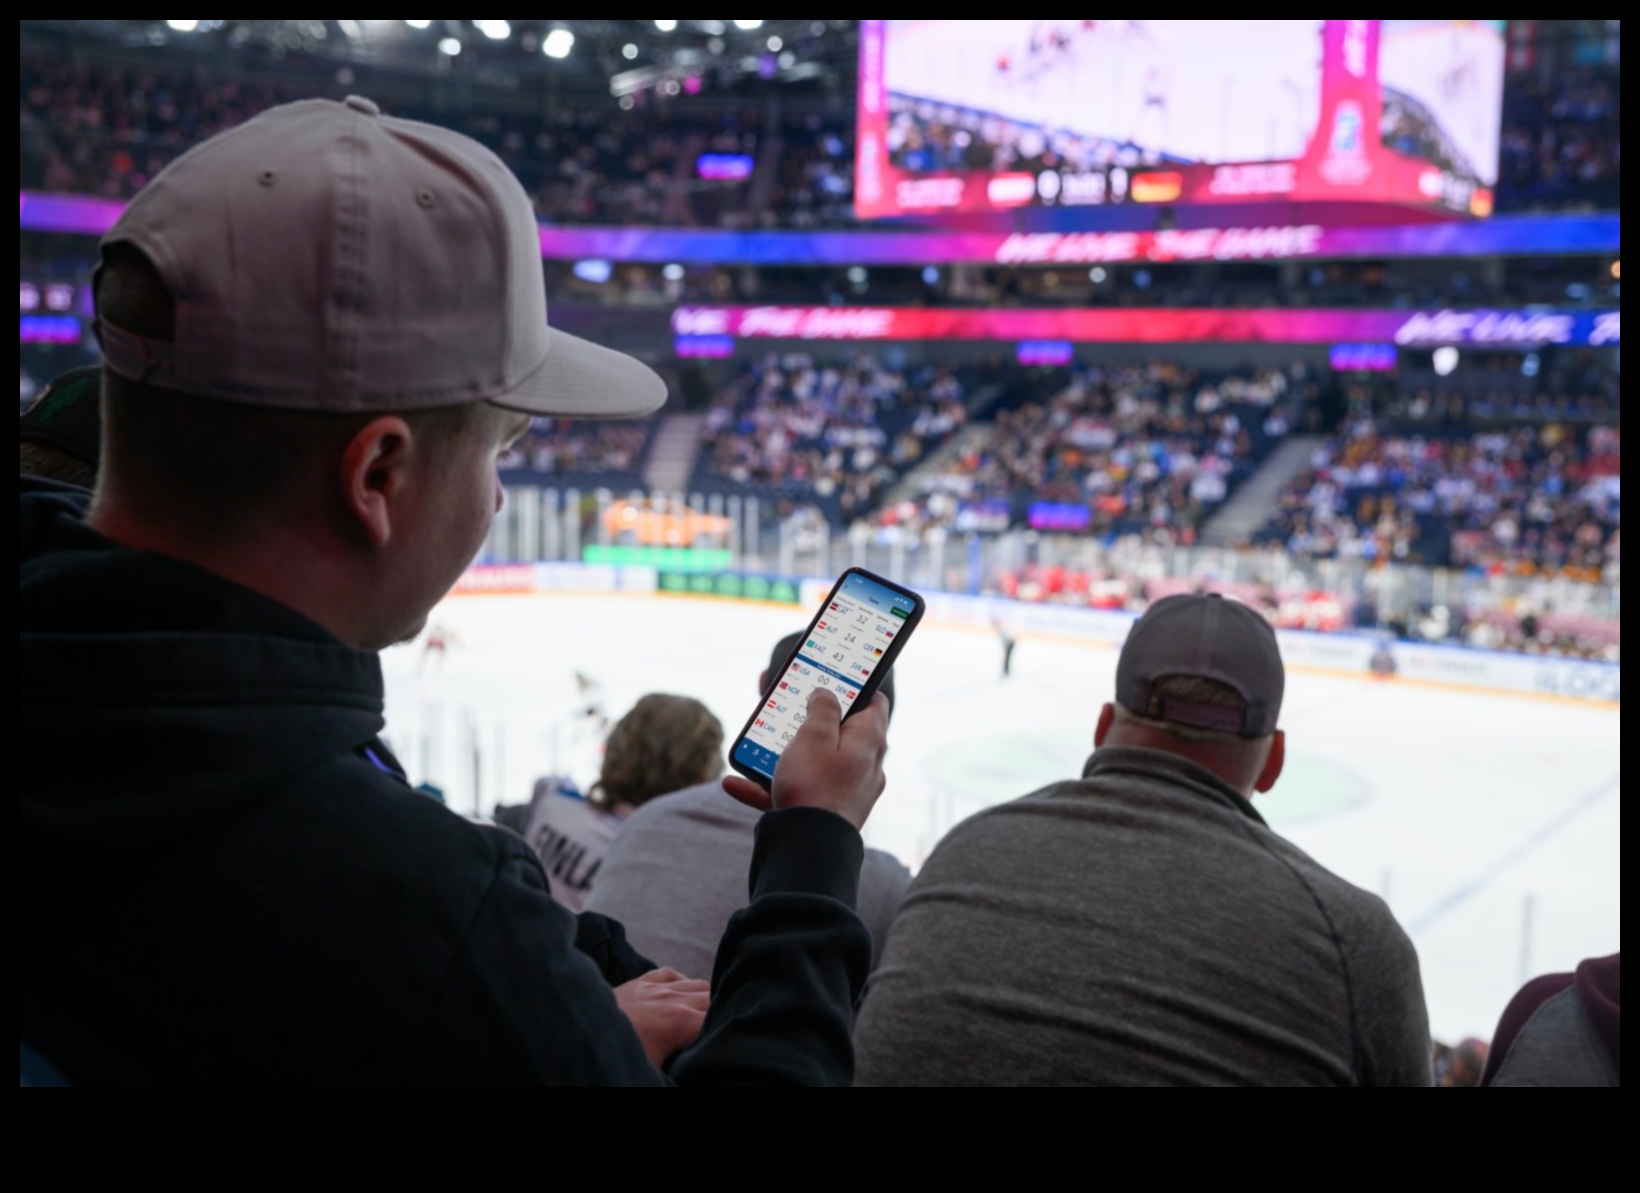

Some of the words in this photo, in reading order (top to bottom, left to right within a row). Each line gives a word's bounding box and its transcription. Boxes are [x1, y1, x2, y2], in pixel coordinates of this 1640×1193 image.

[837, 605, 849, 614] LAT
[856, 614, 868, 625] 3:2
[825, 624, 838, 634] AUT
[844, 633, 856, 643] 2:4
[863, 643, 875, 652] GER
[814, 643, 826, 653] KAZ
[832, 651, 845, 662] 4:3
[787, 685, 800, 695] NOR
[799, 666, 811, 676] USA
[817, 675, 830, 685] 0:0
[835, 685, 847, 695] DEN
[775, 704, 788, 713] AUT
[763, 723, 777, 733] CAN
